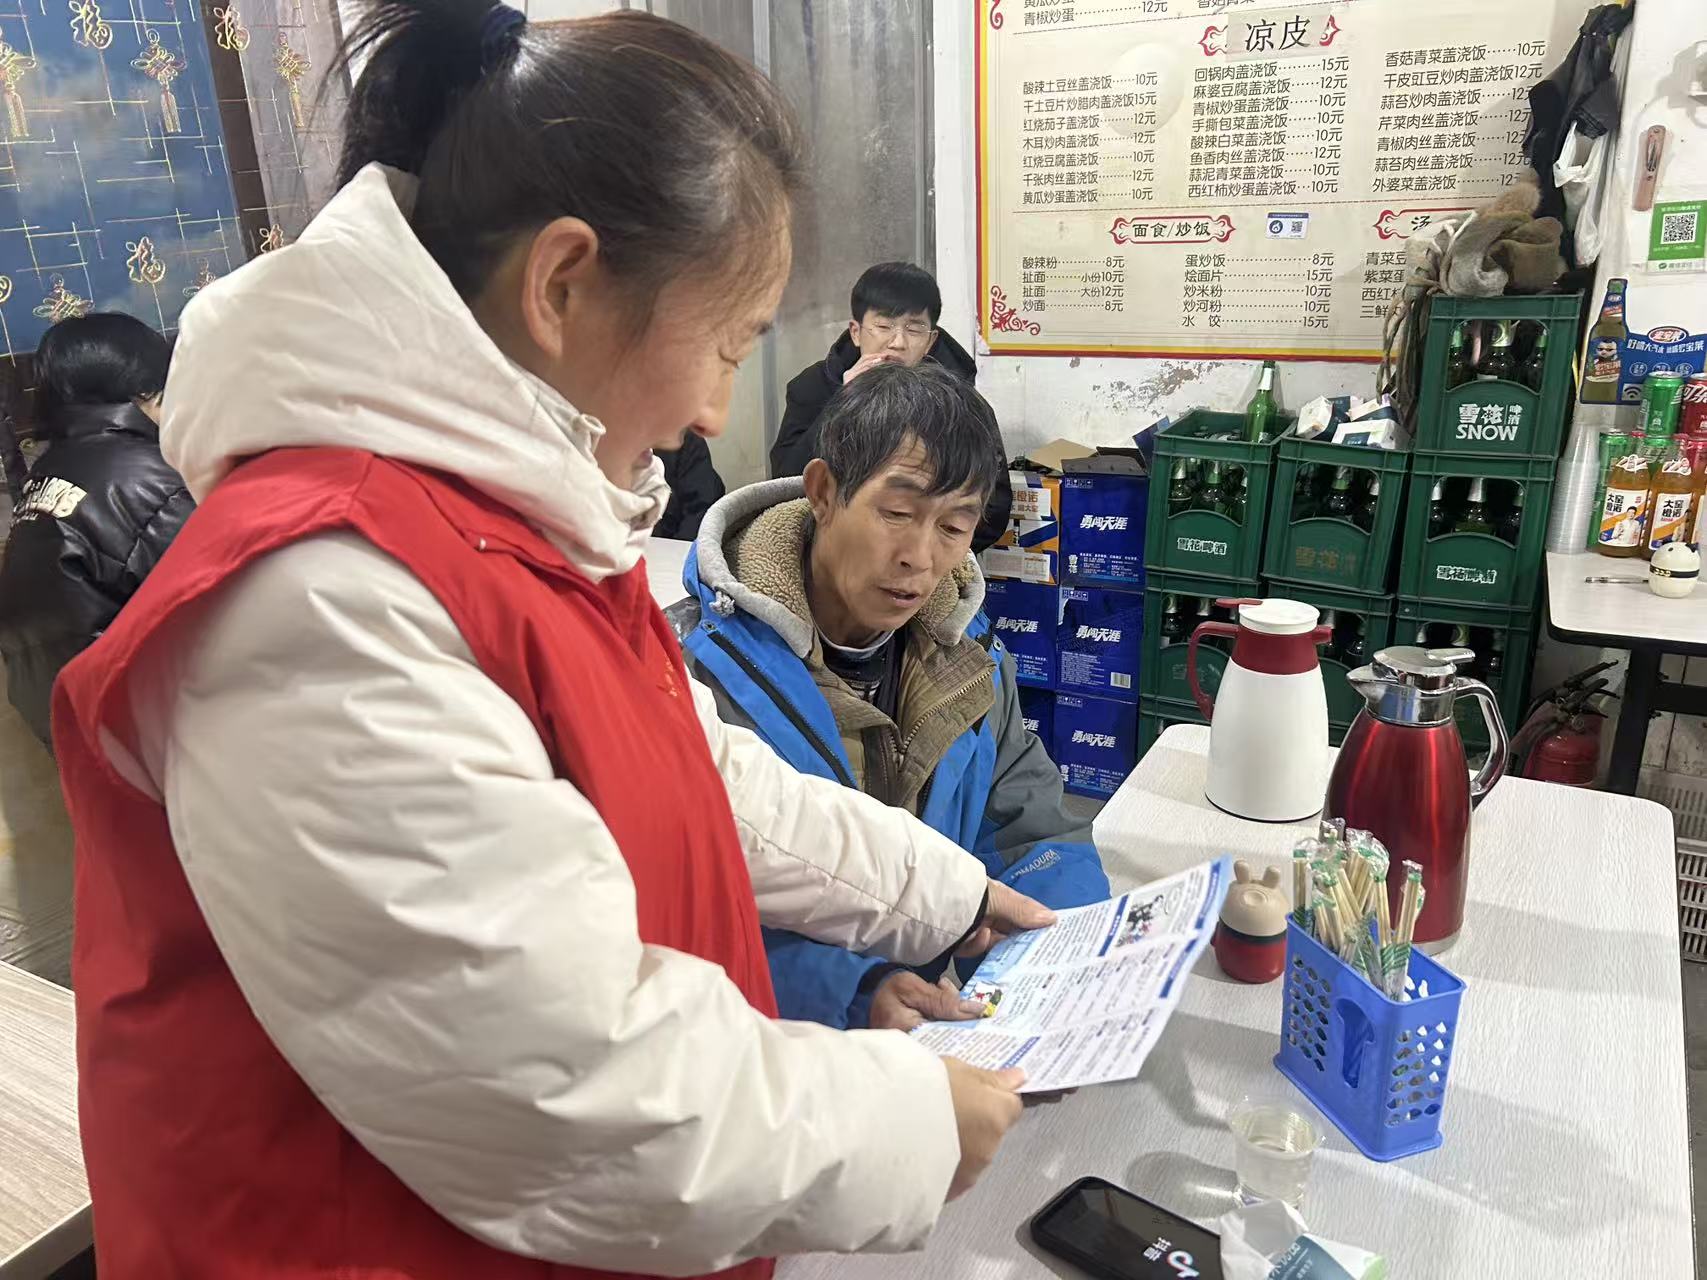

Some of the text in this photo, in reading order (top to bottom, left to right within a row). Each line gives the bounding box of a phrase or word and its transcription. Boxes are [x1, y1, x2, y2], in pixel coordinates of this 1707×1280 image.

[1024, 0, 1168, 26] 青椒炒蛋 12元
[1245, 15, 1311, 51] 凉皮
[1385, 41, 1546, 67] 香菇青菜盖浇饭 10元
[1194, 56, 1349, 82] 回锅肉盖浇饭 15元
[1023, 72, 1158, 95] 酸辣土豆丝盖浇饭 10元
[1193, 74, 1348, 99] 麻婆豆腐盖浇饭 12元
[1193, 92, 1346, 116] 青椒炒蛋盖浇饭 10元
[1023, 111, 1156, 132] 红烧茄子盖浇饭 12元
[1192, 110, 1345, 133] 手撕包菜盖浇饭 10元
[1377, 110, 1479, 131] 芹菜肉丝盖浇饭
[1023, 130, 1156, 150] 木耳炒肉盖浇饭 12元
[1191, 128, 1343, 150] 酸辣白菜盖浇饭 10元
[1377, 132, 1476, 152] 青椒肉丝盖浇饭
[1023, 150, 1155, 168] 红烧豆腐盖浇饭 10元
[1190, 145, 1341, 166] 鱼香肉丝盖浇饭 12元
[1132, 168, 1154, 182] 12元
[1188, 162, 1340, 182] 蒜泥青菜盖浇饭 10元
[1188, 179, 1338, 198] 西红柿炒蛋盖浇饭 10元
[1373, 175, 1457, 192] 外婆菜盖浇饭
[1022, 187, 1153, 204] 黄瓜炒蛋盖浇饭 10元
[1132, 221, 1211, 238] 面食/炒饭
[1022, 255, 1125, 269] 酸辣粉 8元
[1185, 252, 1334, 268] 蛋炒饭 8元
[1184, 269, 1333, 283] 烩面片 15元
[1183, 284, 1331, 298] 炒米粉 10元
[1022, 299, 1124, 312] 炒面 8元
[1182, 300, 1330, 313] 炒河粉 10元
[1182, 315, 1329, 329] 水 饺 15元
[1459, 403, 1504, 425] 雪花
[1456, 424, 1519, 441] SNOW
[1080, 514, 1129, 531] 勇闯天涯
[995, 616, 1039, 633] 勇闯天涯
[1076, 625, 1121, 643] 勇闯天涯
[1071, 729, 1117, 748] 勇闯天涯
